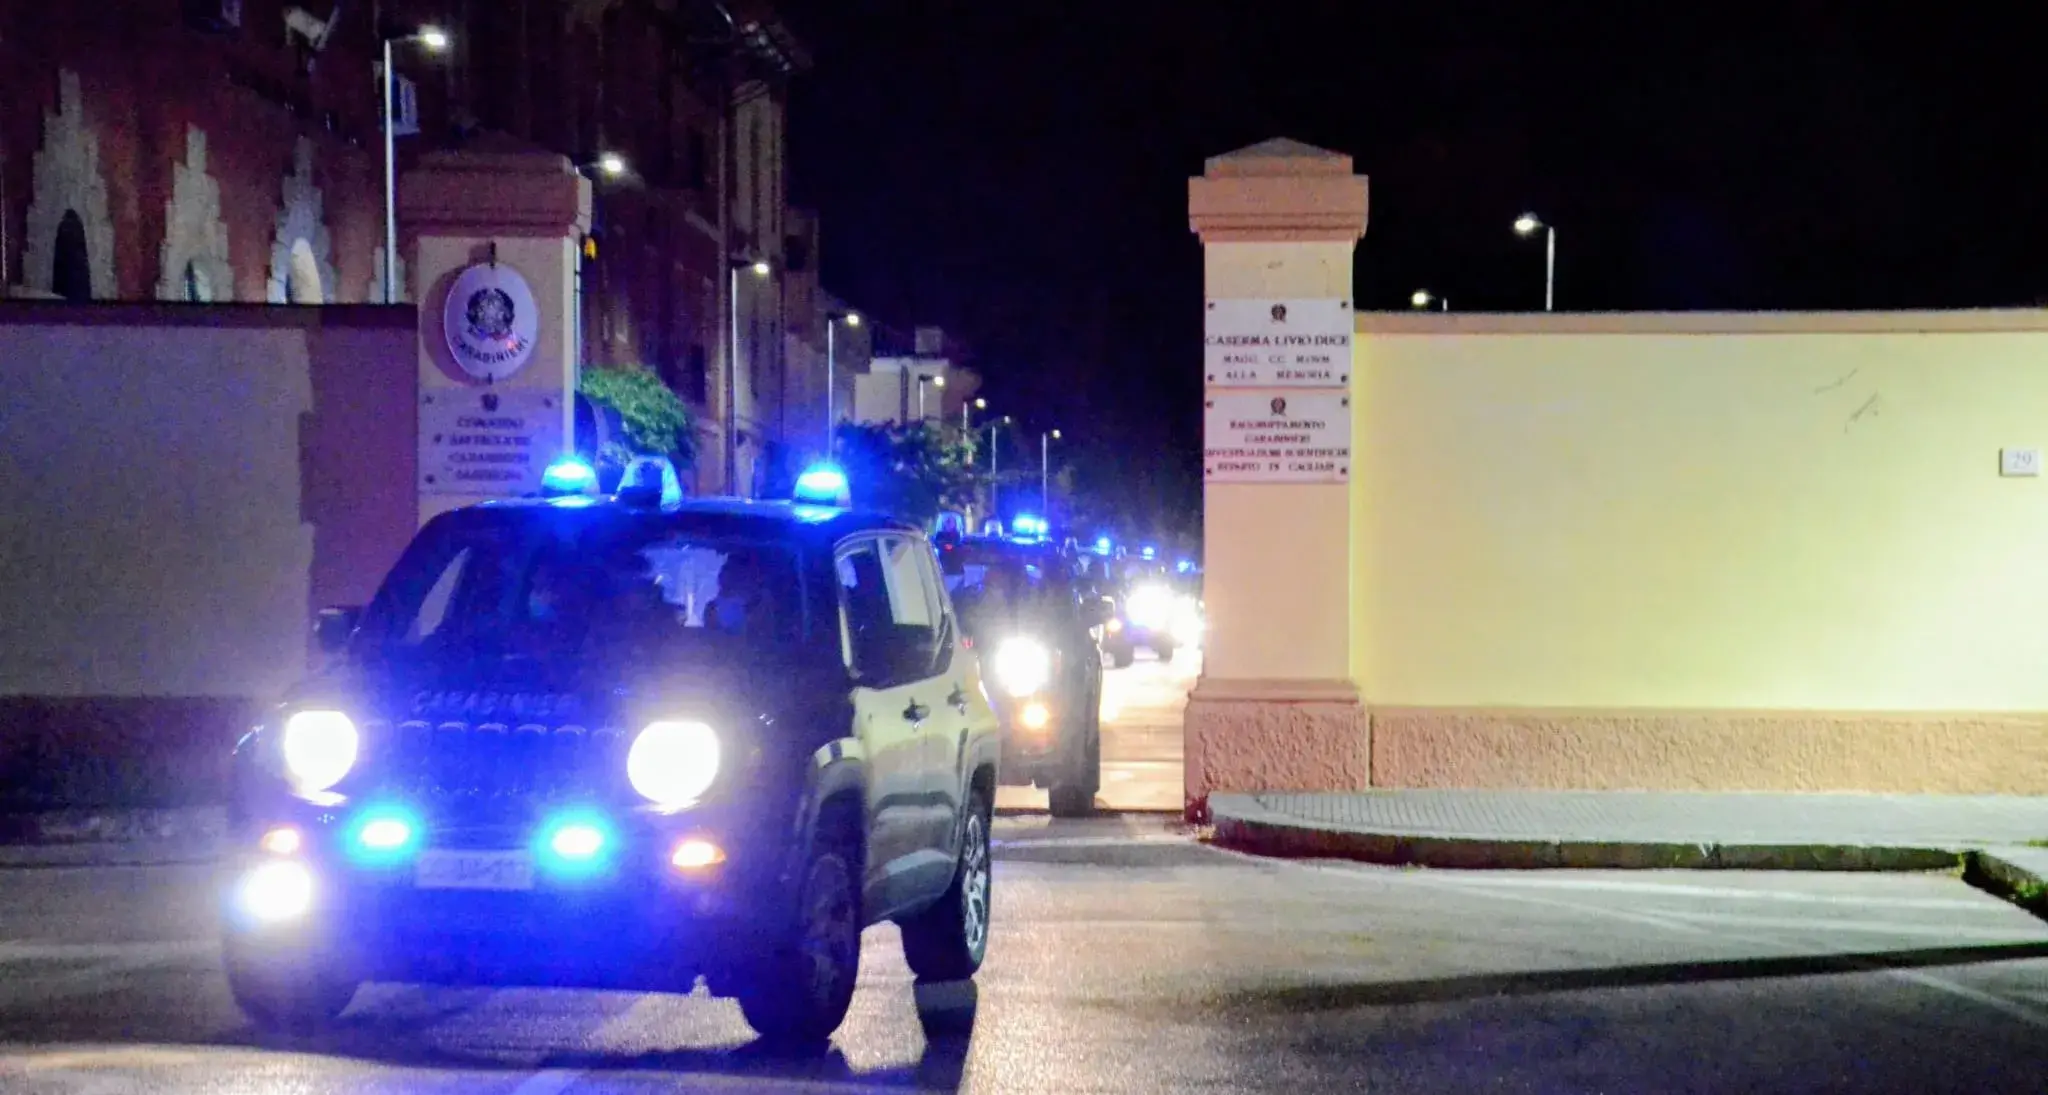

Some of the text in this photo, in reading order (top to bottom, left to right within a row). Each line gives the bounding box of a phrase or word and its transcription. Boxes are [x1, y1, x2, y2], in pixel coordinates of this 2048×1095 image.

[1206, 335, 1270, 346] CASERMA
[1226, 371, 1330, 380] ALLA MEMORIA
